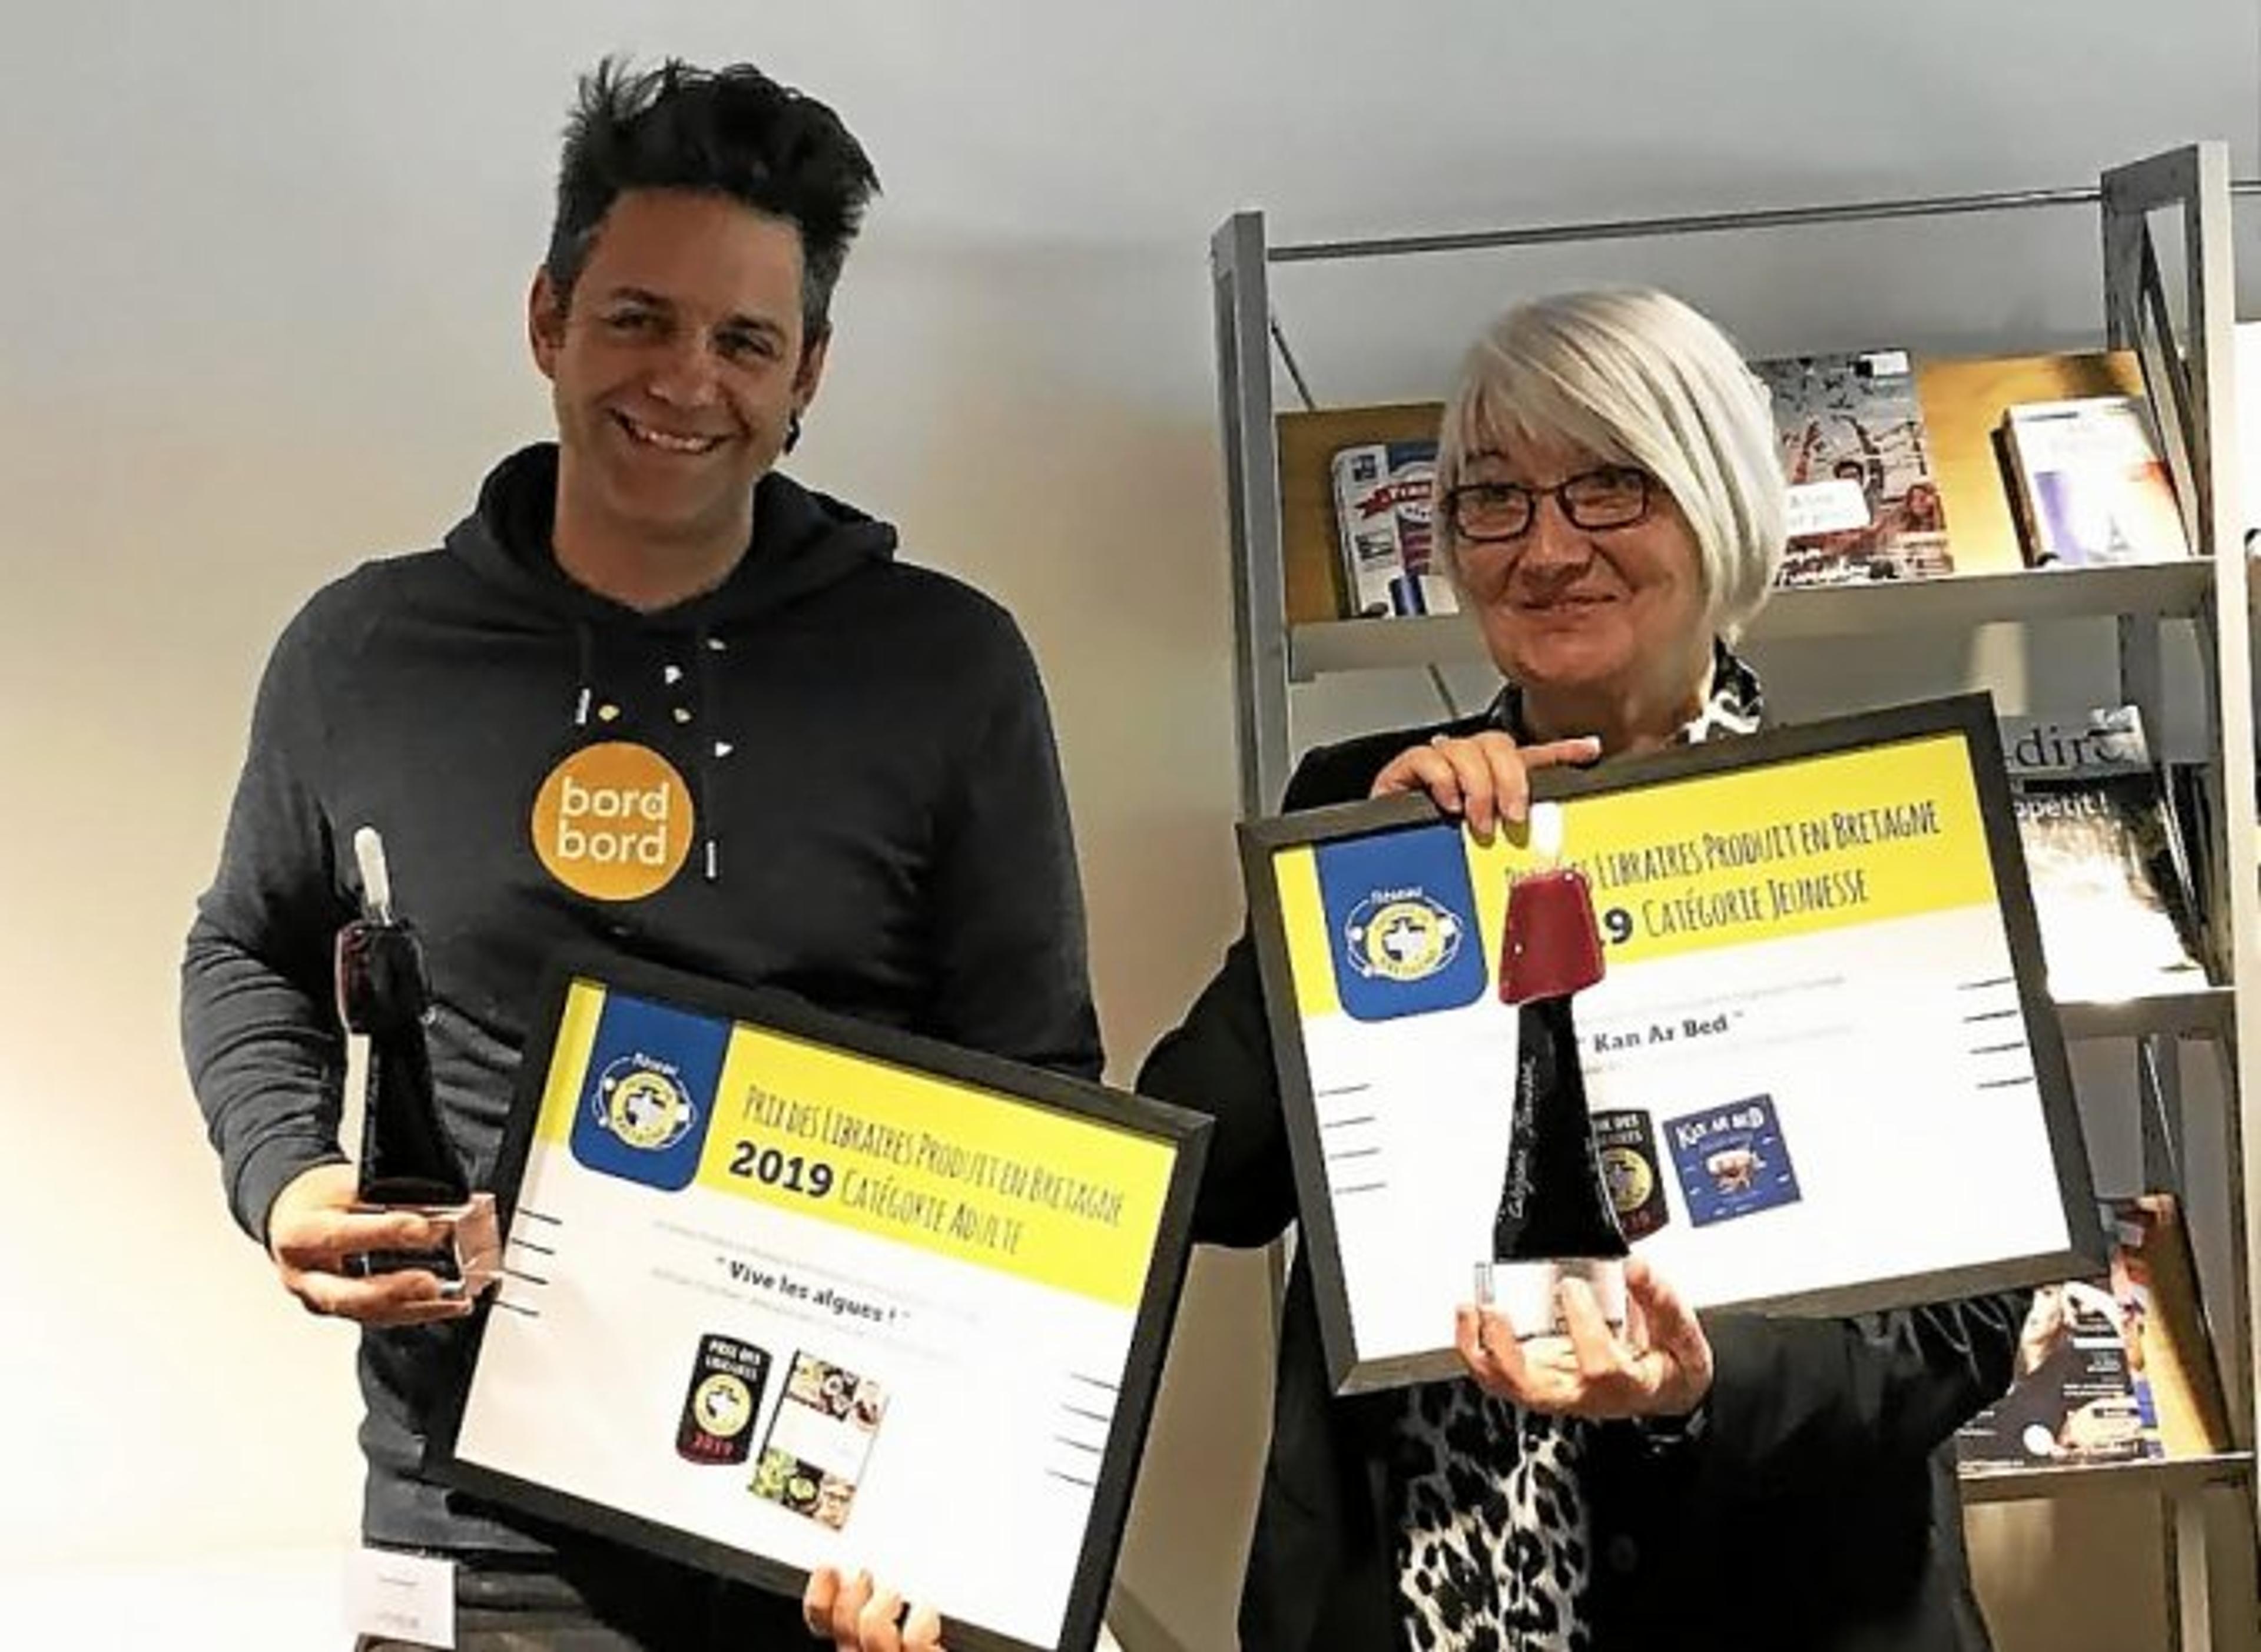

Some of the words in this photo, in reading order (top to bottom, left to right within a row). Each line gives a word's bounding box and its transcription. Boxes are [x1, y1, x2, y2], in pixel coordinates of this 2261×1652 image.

[561, 775, 670, 821] bord
[558, 819, 668, 865] bord
[1594, 841, 1702, 890] LIBRAIRES
[1702, 823, 1797, 871] PRODUIT
[1799, 819, 1831, 855] EN
[1830, 800, 1942, 850] BRETAGNE
[1642, 885, 1764, 937] CATÉGORIE
[1766, 868, 1869, 921] JEUNESSE
[1593, 1030, 1641, 1053] Kan
[1648, 1024, 1676, 1044] Ar
[1682, 1013, 1729, 1038] Bed
[728, 1140, 834, 1198] 2019
[728, 1259, 777, 1289] Vive
[779, 1274, 809, 1300] les
[812, 1289, 883, 1323] algues
